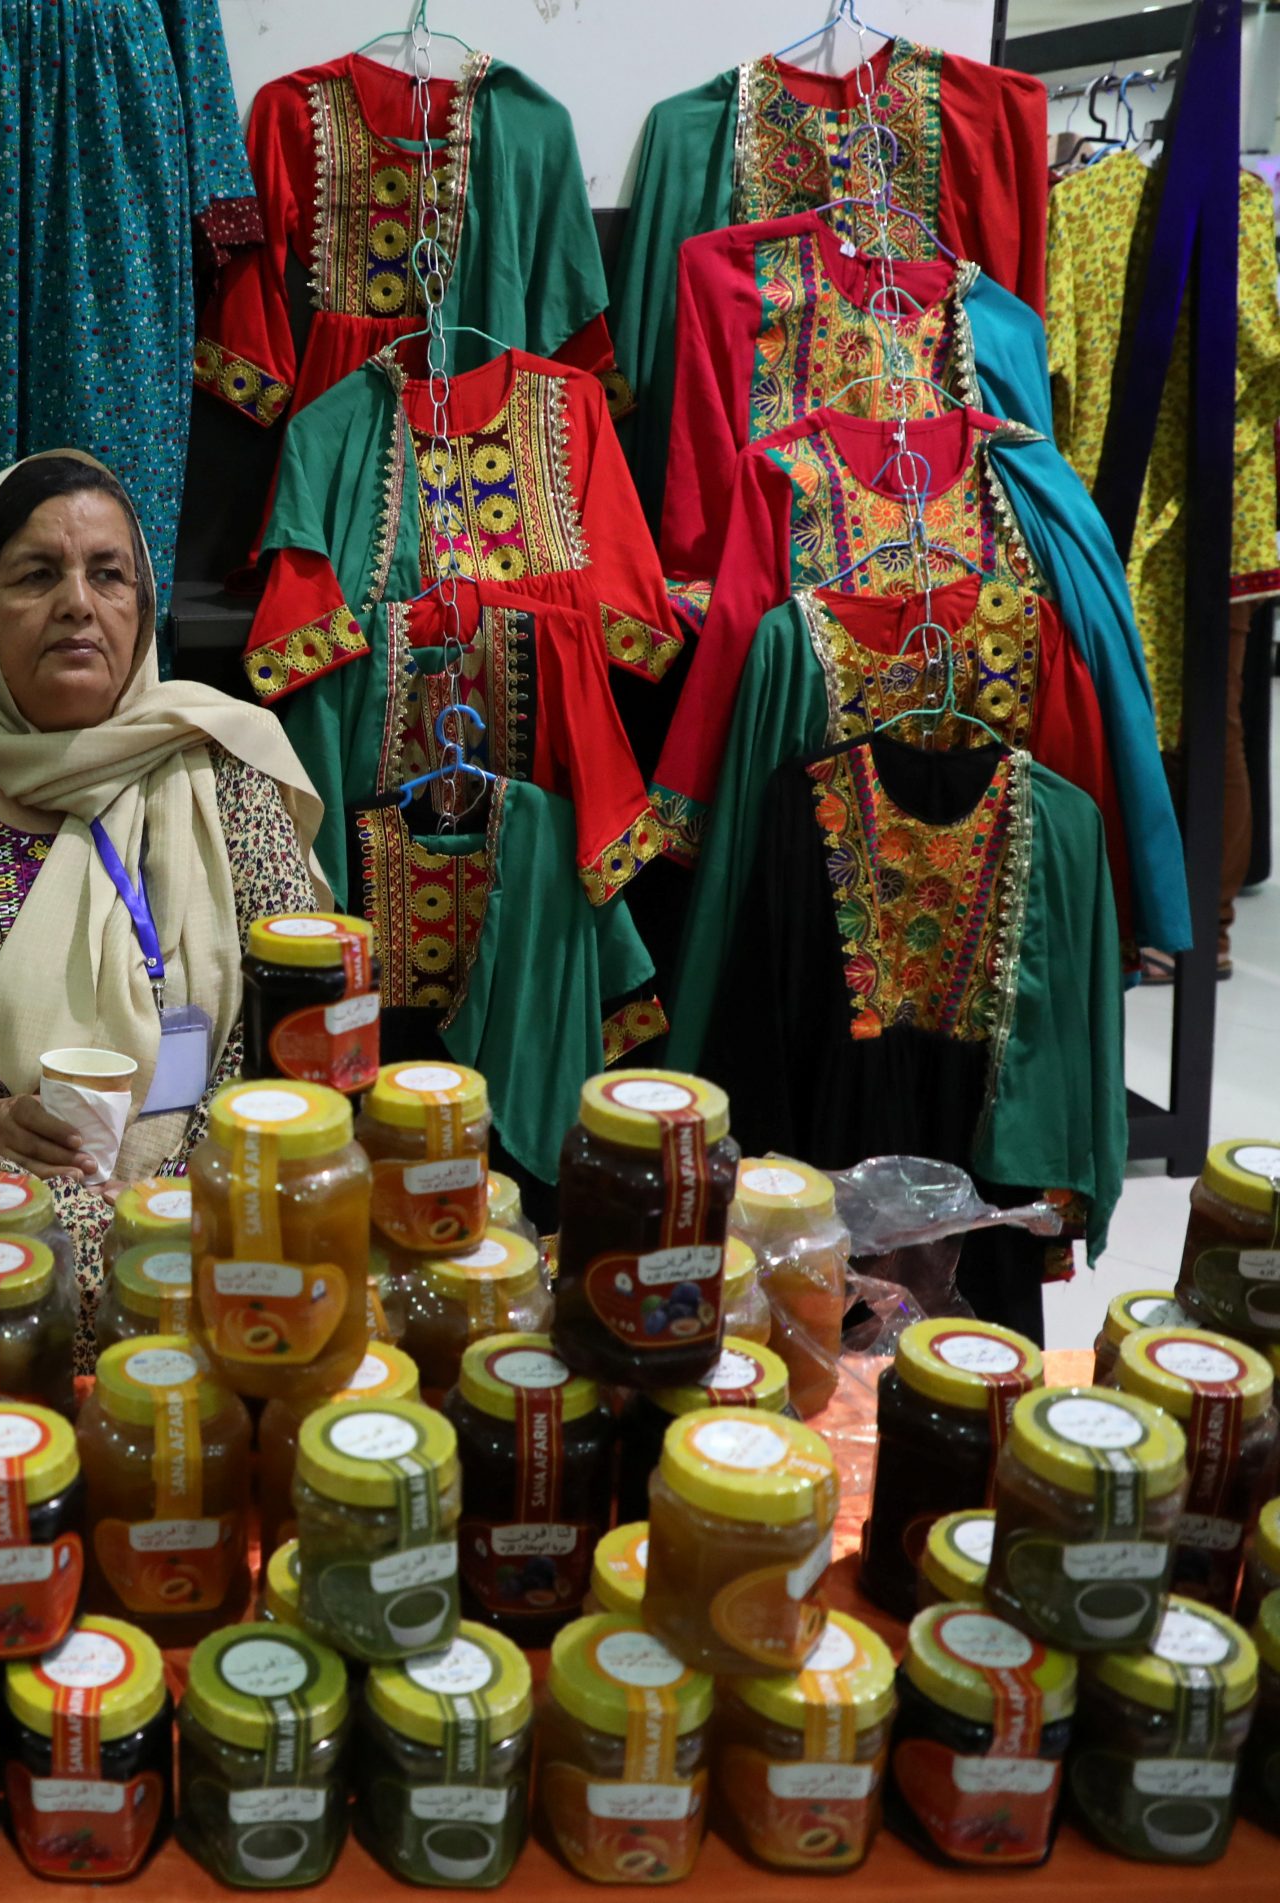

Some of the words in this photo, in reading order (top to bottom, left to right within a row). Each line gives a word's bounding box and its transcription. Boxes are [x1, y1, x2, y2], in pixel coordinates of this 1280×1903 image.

[354, 956, 366, 990] SANA
[679, 1125, 696, 1187] AFARIN
[679, 1190, 697, 1229] SANA
[532, 1412, 549, 1471] AFARIN
[531, 1472, 547, 1508] SANA
[499, 1526, 554, 1543] آفرین
